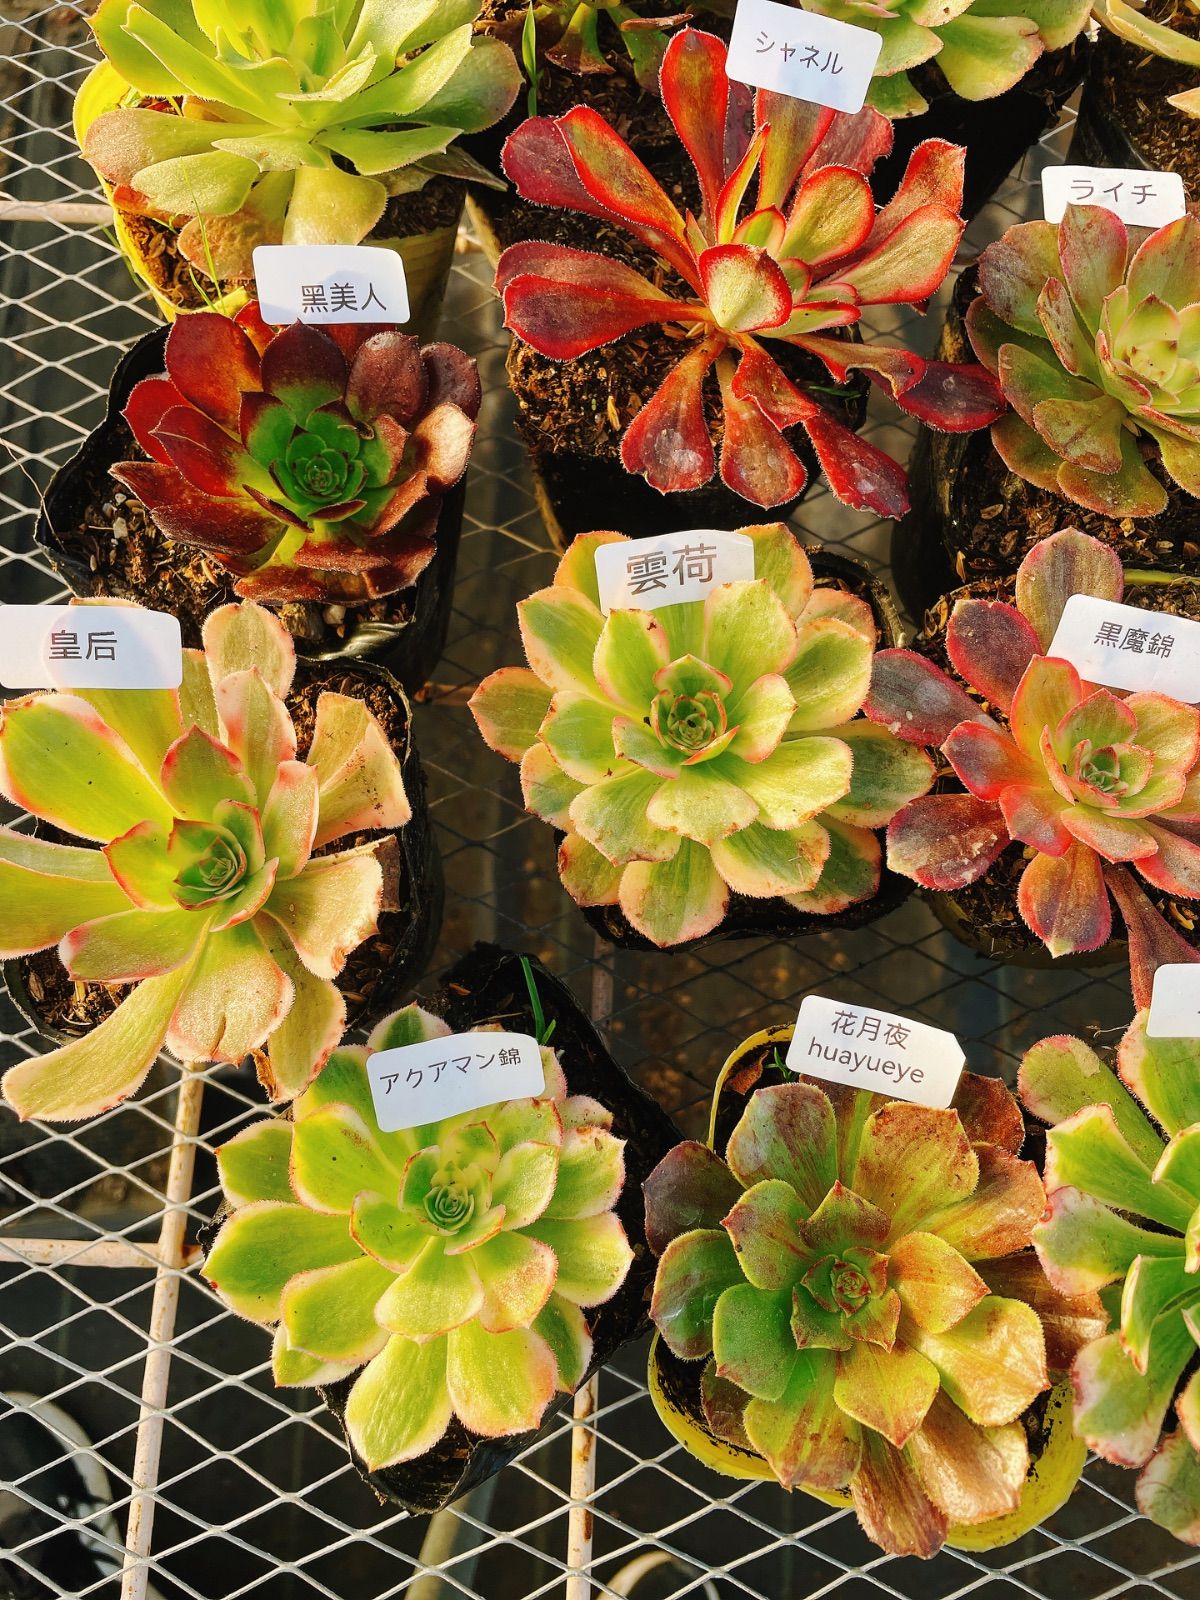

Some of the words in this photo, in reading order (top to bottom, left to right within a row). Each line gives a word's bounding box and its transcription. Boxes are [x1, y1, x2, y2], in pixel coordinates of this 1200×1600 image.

[755, 31, 844, 75] シャネル
[1070, 179, 1157, 205] ライチ
[626, 543, 717, 595] 雲荷
[48, 630, 118, 661] 皇后
[1093, 621, 1176, 659] 黒魔錦
[831, 1010, 912, 1050] 花月夜
[379, 1047, 522, 1095] アクアマン錦
[807, 1036, 925, 1084] huayueye
